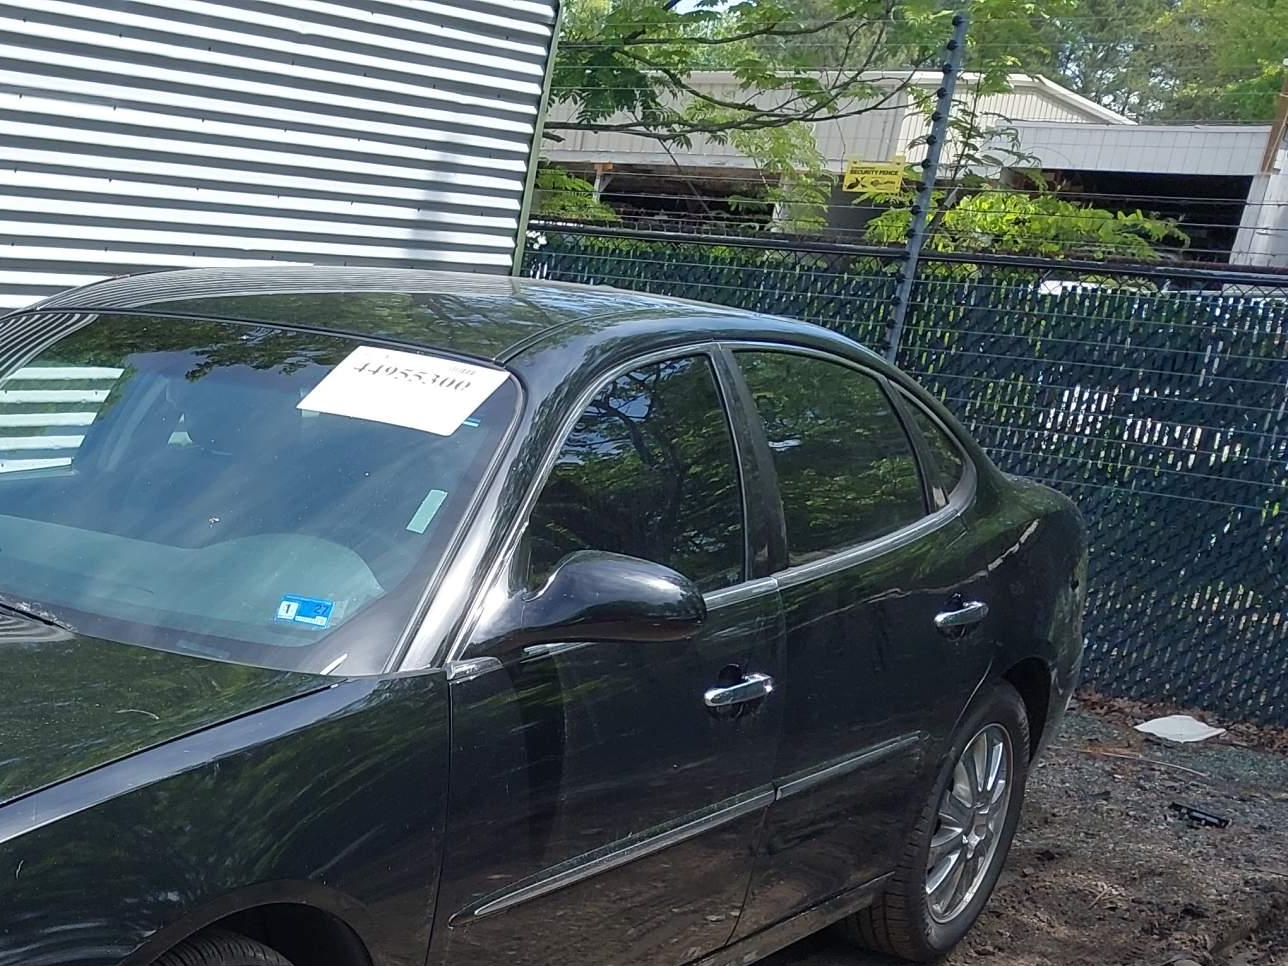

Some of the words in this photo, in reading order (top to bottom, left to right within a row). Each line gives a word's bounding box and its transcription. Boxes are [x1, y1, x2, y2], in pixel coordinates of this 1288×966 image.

[352, 361, 472, 392] 44955300
[284, 603, 291, 614] 1
[313, 604, 329, 616] 27
